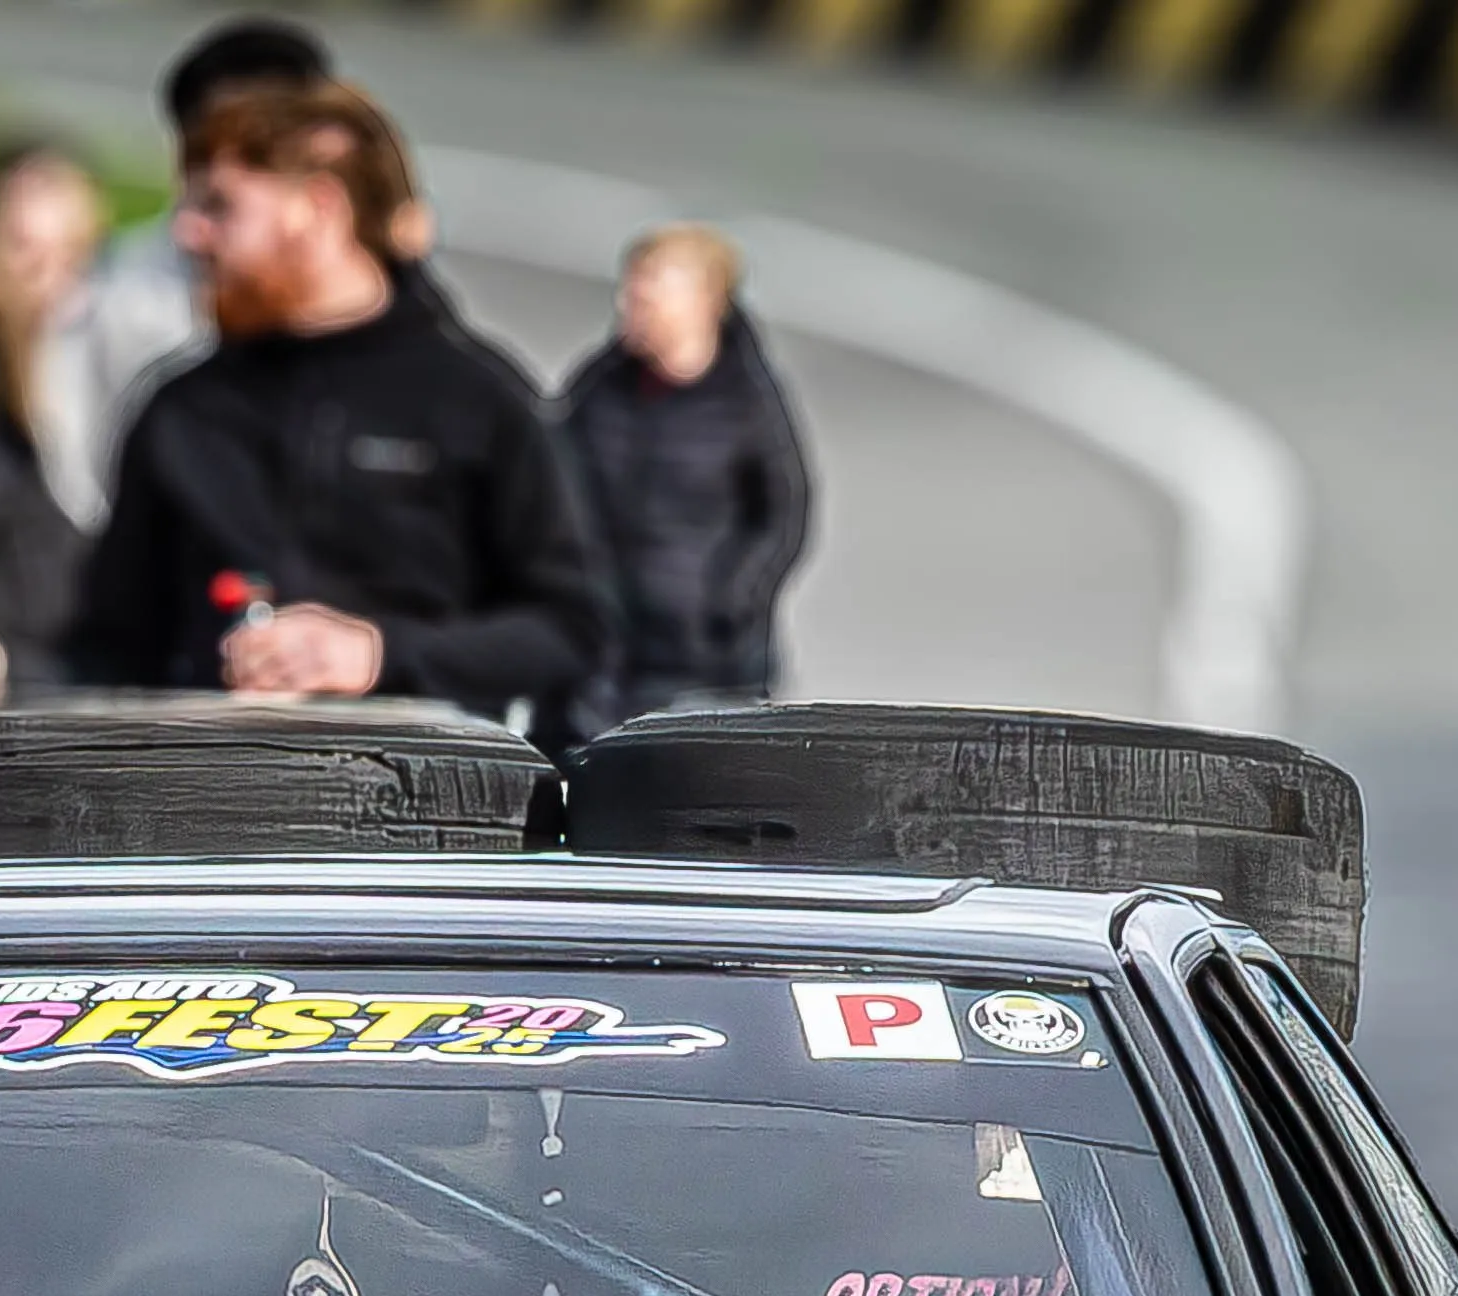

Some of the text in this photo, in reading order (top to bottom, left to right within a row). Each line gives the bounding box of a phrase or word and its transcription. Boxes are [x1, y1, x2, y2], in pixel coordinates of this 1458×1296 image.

[97, 980, 260, 1001] AUTO
[835, 993, 923, 1047] P
[436, 1027, 557, 1055] 25
